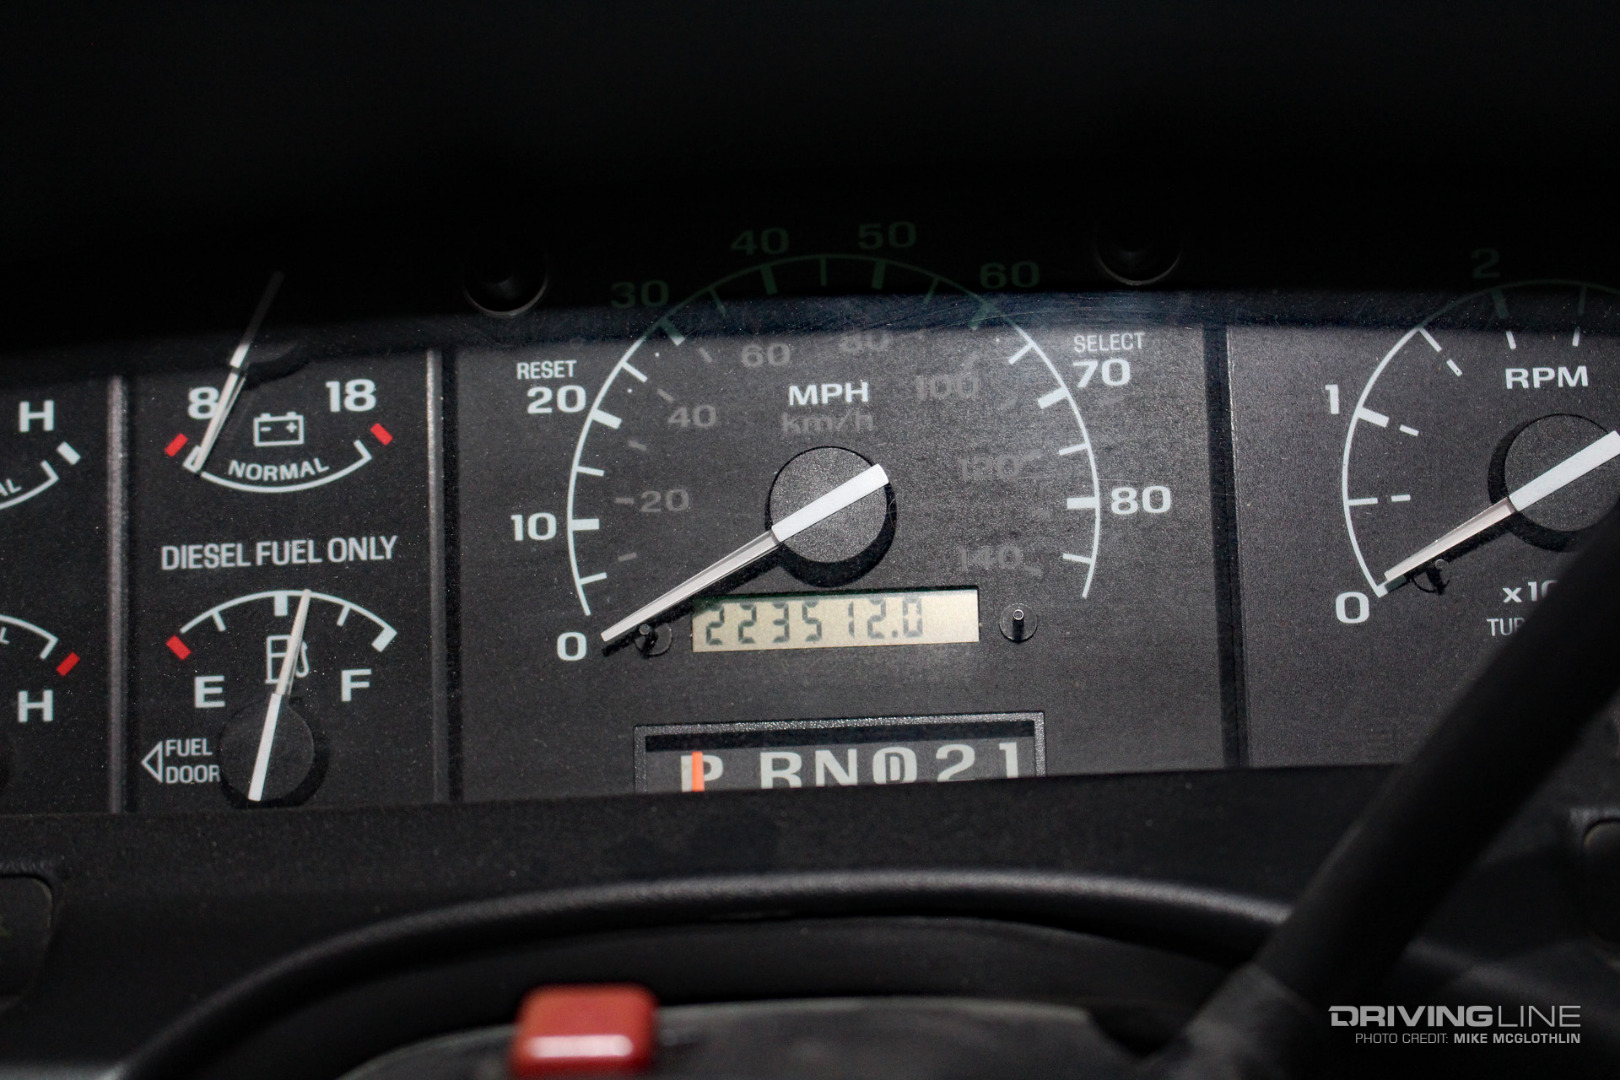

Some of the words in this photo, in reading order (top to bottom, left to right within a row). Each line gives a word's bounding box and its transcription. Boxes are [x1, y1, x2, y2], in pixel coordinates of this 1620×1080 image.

[730, 227, 789, 256] 40
[857, 221, 917, 250] 50
[979, 261, 1040, 290] 60
[1470, 248, 1500, 278] 2
[610, 279, 670, 309] 30
[741, 342, 791, 368] 60
[1073, 331, 1146, 353] SELECT
[516, 360, 577, 380] RESET
[1072, 358, 1131, 388] 70
[1505, 365, 1590, 390] RPM
[325, 378, 377, 413] 18
[527, 385, 587, 414] 20
[788, 381, 870, 407] MPH
[914, 373, 979, 400] 100
[1325, 384, 1340, 414] 1
[18, 400, 55, 432] H
[187, 387, 220, 420] 8
[667, 404, 717, 429] 40
[781, 409, 874, 436] km/h
[228, 457, 330, 482] NORMAL
[640, 488, 690, 513] 20
[1110, 485, 1172, 515] 80
[510, 512, 557, 541] 10
[161, 542, 251, 571] DIESEL
[255, 539, 323, 567] FUEL
[327, 535, 398, 563] ONLY
[1335, 591, 1370, 624] 0
[556, 631, 587, 661] 0
[194, 675, 226, 708] E
[341, 669, 372, 702] F
[17, 689, 54, 723] H
[165, 738, 213, 757] FUEL
[165, 764, 221, 784] DOOR
[680, 752, 724, 792] P
[759, 752, 802, 789] R
[815, 749, 858, 786] N
[935, 743, 976, 783] 2
[999, 742, 1020, 779] 1
